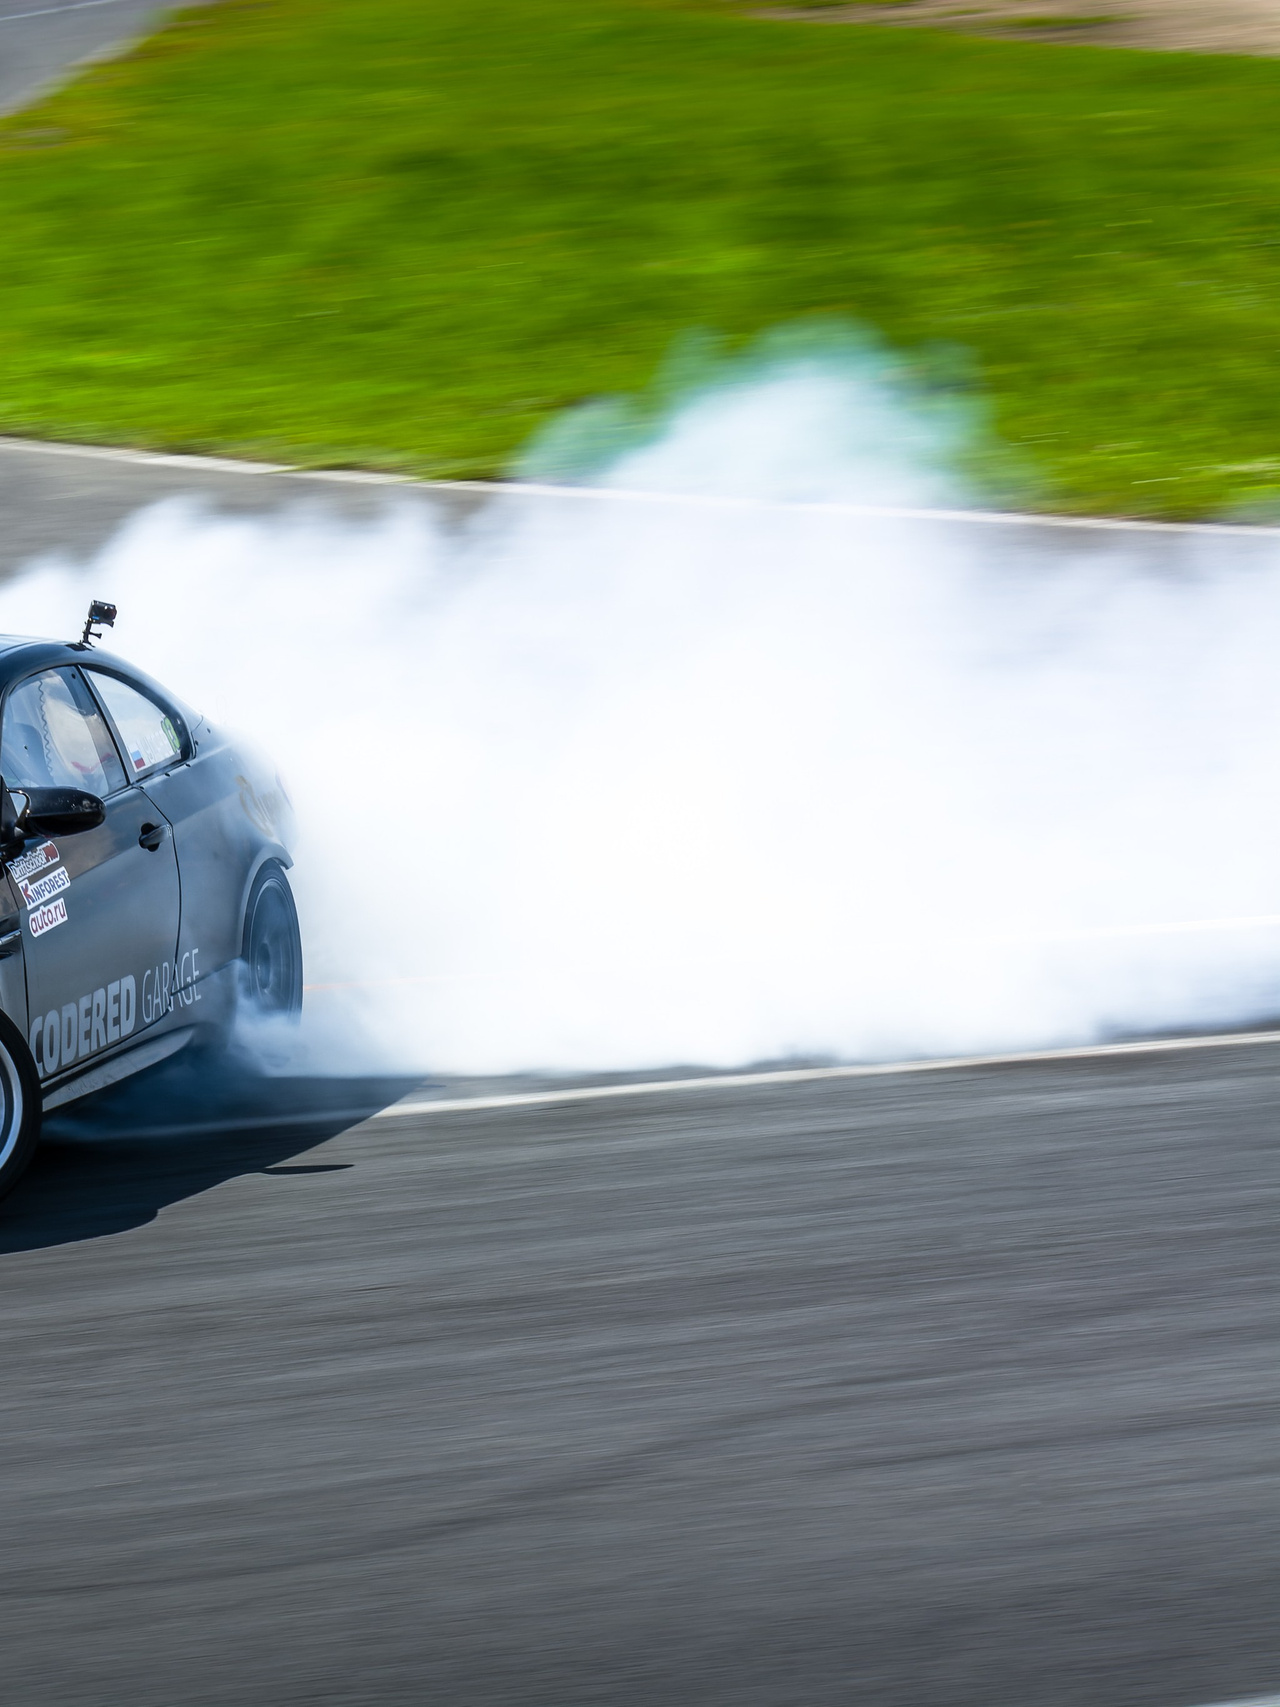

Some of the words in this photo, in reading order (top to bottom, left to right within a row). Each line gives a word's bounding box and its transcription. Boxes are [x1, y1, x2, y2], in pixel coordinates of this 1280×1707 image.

[21, 869, 70, 906] KINFOREST
[30, 901, 66, 934] auto.ru
[29, 974, 136, 1079] CODERED
[142, 948, 202, 1024] GARAGE
